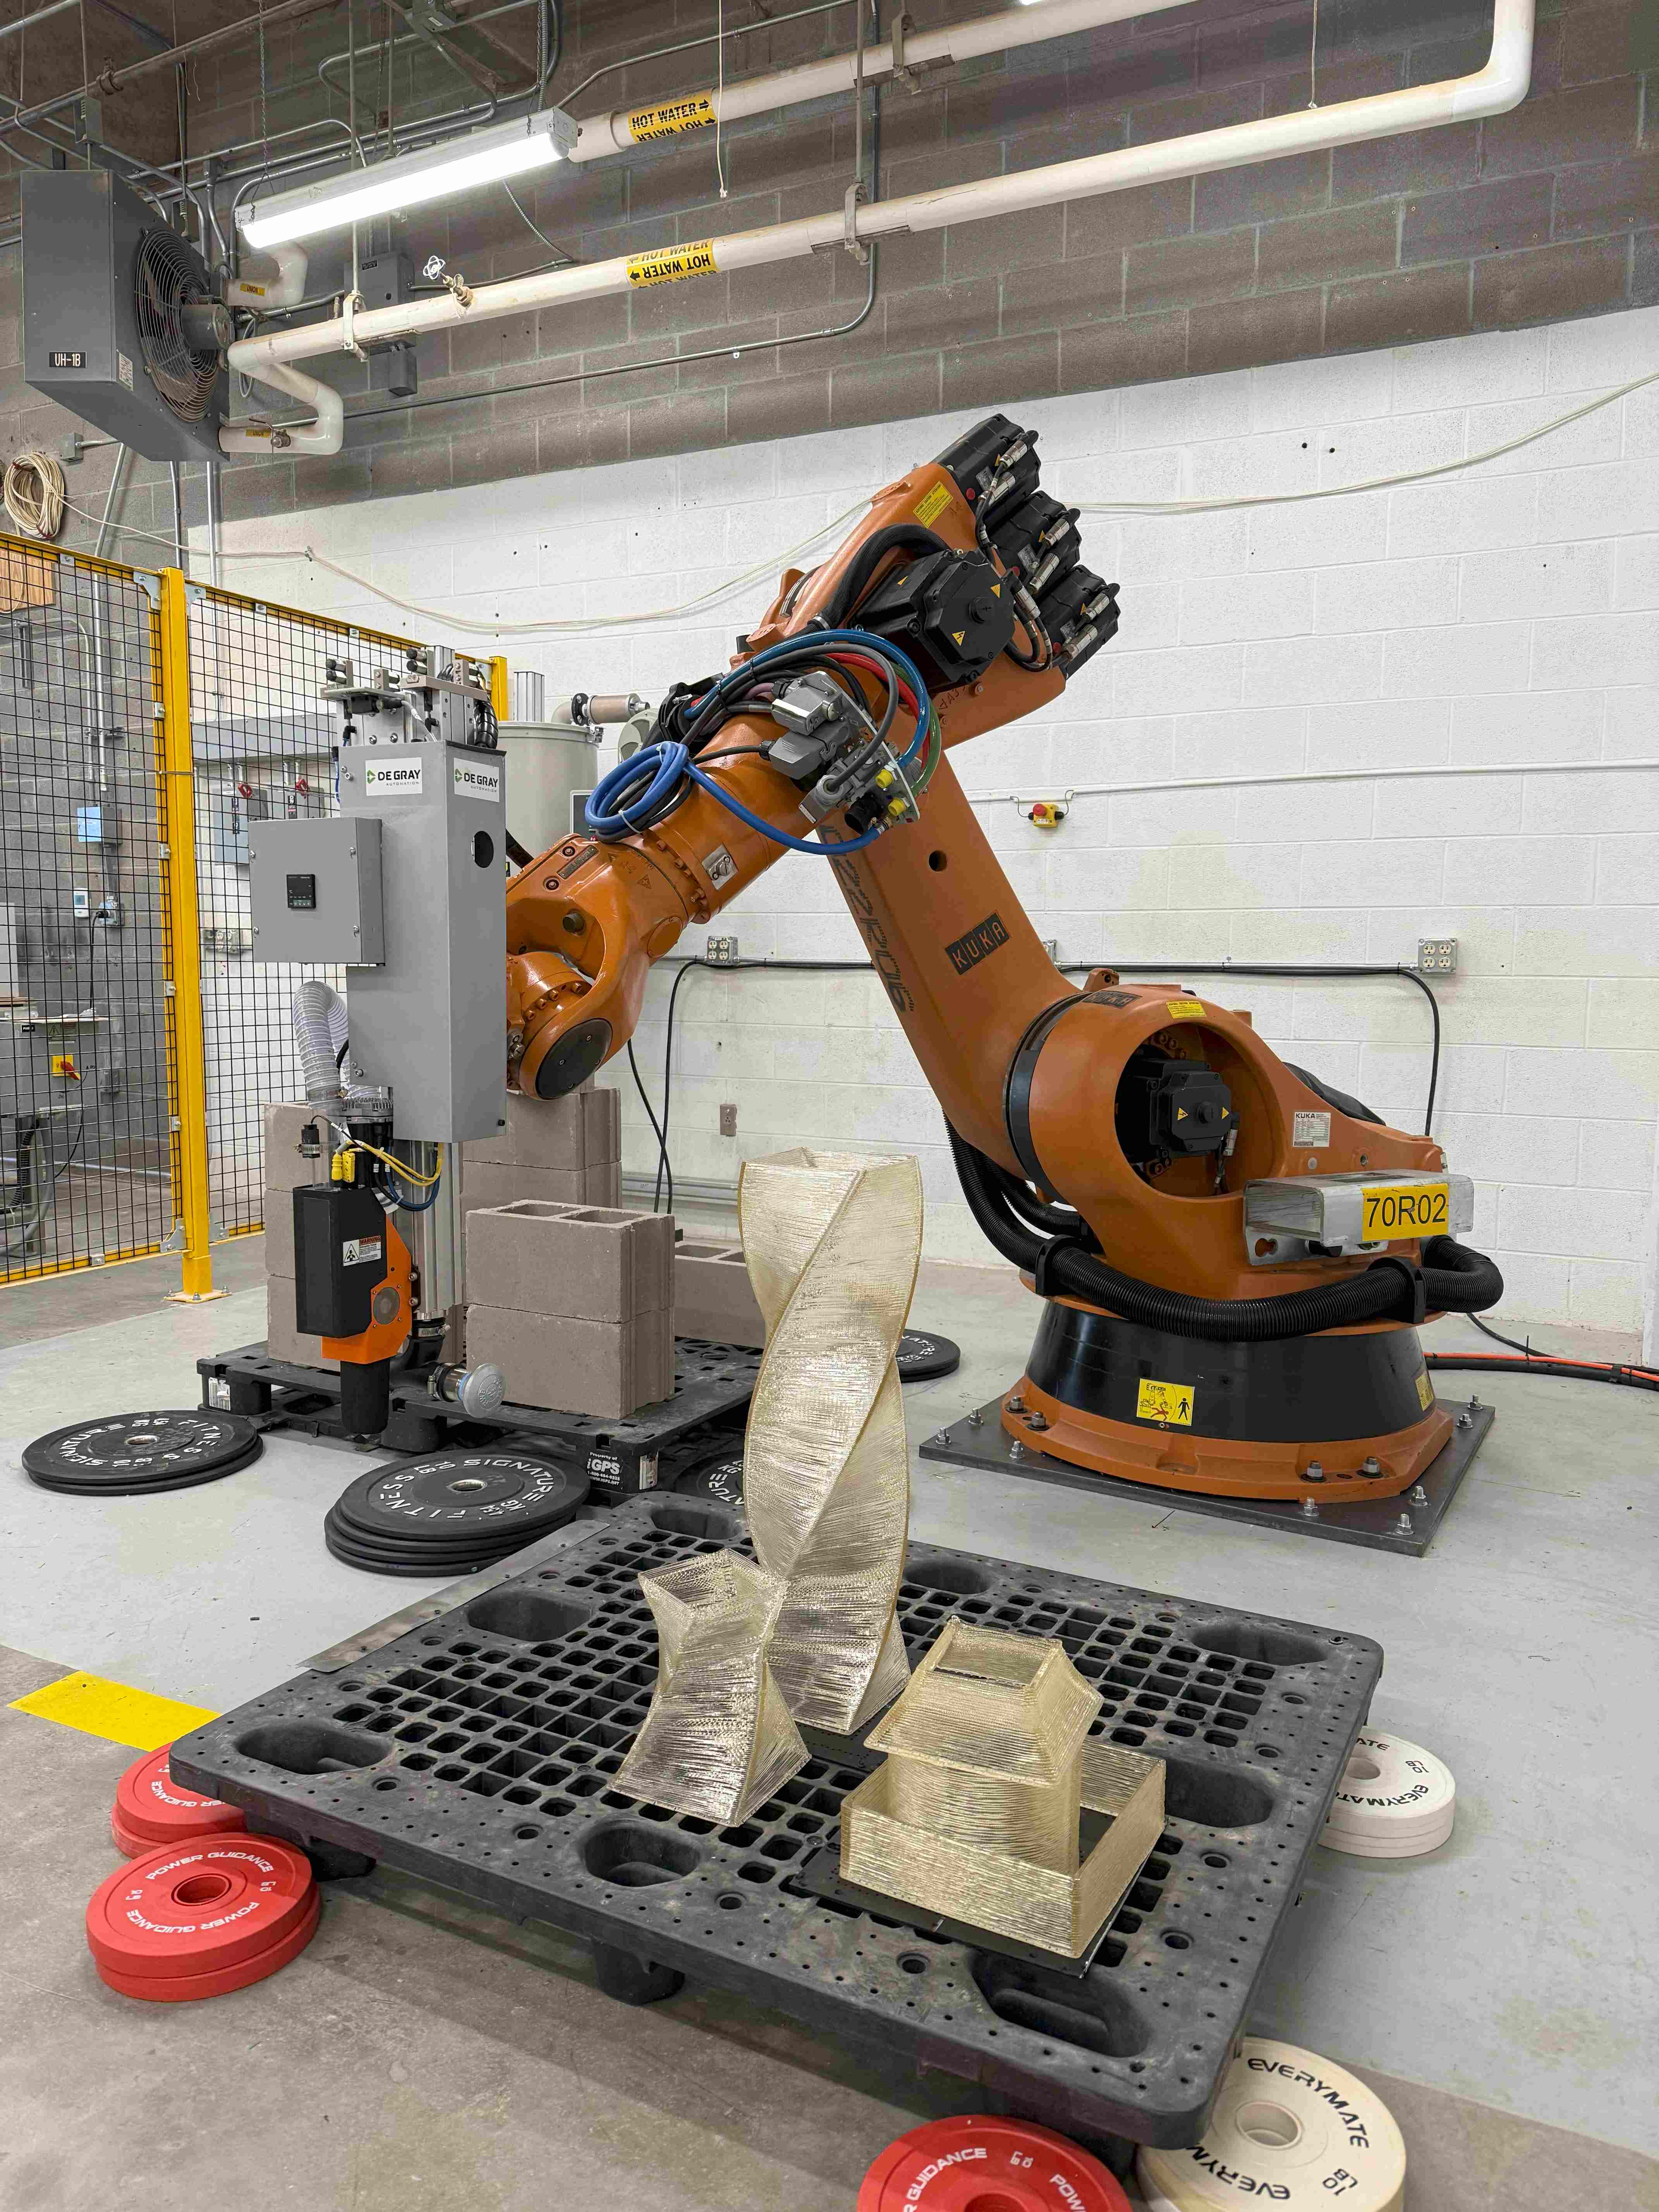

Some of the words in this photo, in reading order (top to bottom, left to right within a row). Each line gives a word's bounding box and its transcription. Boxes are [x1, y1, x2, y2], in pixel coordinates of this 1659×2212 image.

[632, 113, 654, 130] HOT
[658, 103, 697, 123] WATER
[637, 127, 677, 142] WATER
[679, 120, 703, 132] HOT
[641, 251, 664, 261] HOT
[669, 240, 709, 256] WATER
[642, 260, 684, 278] WATER
[687, 254, 711, 270] HOT
[55, 353, 81, 366] UH-1B
[378, 771, 392, 781] DE
[393, 769, 421, 780] GRAY
[464, 772, 476, 783] DE
[477, 775, 498, 787] GRAY
[951, 922, 1005, 968] KUKA
[1367, 1193, 1446, 1228] 70R02
[359, 1235, 381, 1245] WARNING
[132, 1419, 150, 1427] KG
[59, 1423, 126, 1466] SIGNATURE
[162, 1419, 222, 1460] FITNESS
[112, 1459, 132, 1467] 10
[133, 1457, 153, 1467] LB
[589, 1451, 611, 1460] Property
[414, 1464, 437, 1474] LB
[435, 1461, 456, 1470] 10
[587, 1458, 620, 1475] iGPS
[717, 1465, 742, 1474] KG
[463, 1458, 555, 1502] SIGNATURE
[380, 1474, 466, 1519] FITNESS
[501, 1499, 526, 1511] KG
[151, 1781, 198, 1807] GUIDANCE
[145, 1854, 203, 1880] POWER
[207, 1851, 274, 1872] GUIDANCE
[126, 1909, 196, 1933] GUIDANCE
[200, 1902, 261, 1930] POWER
[1247, 2058, 1370, 2149] EVERYMATE
[906, 2147, 987, 2201] GUIDANCE
[1333, 2169, 1358, 2188] LB
[1322, 2178, 1347, 2197] 10
